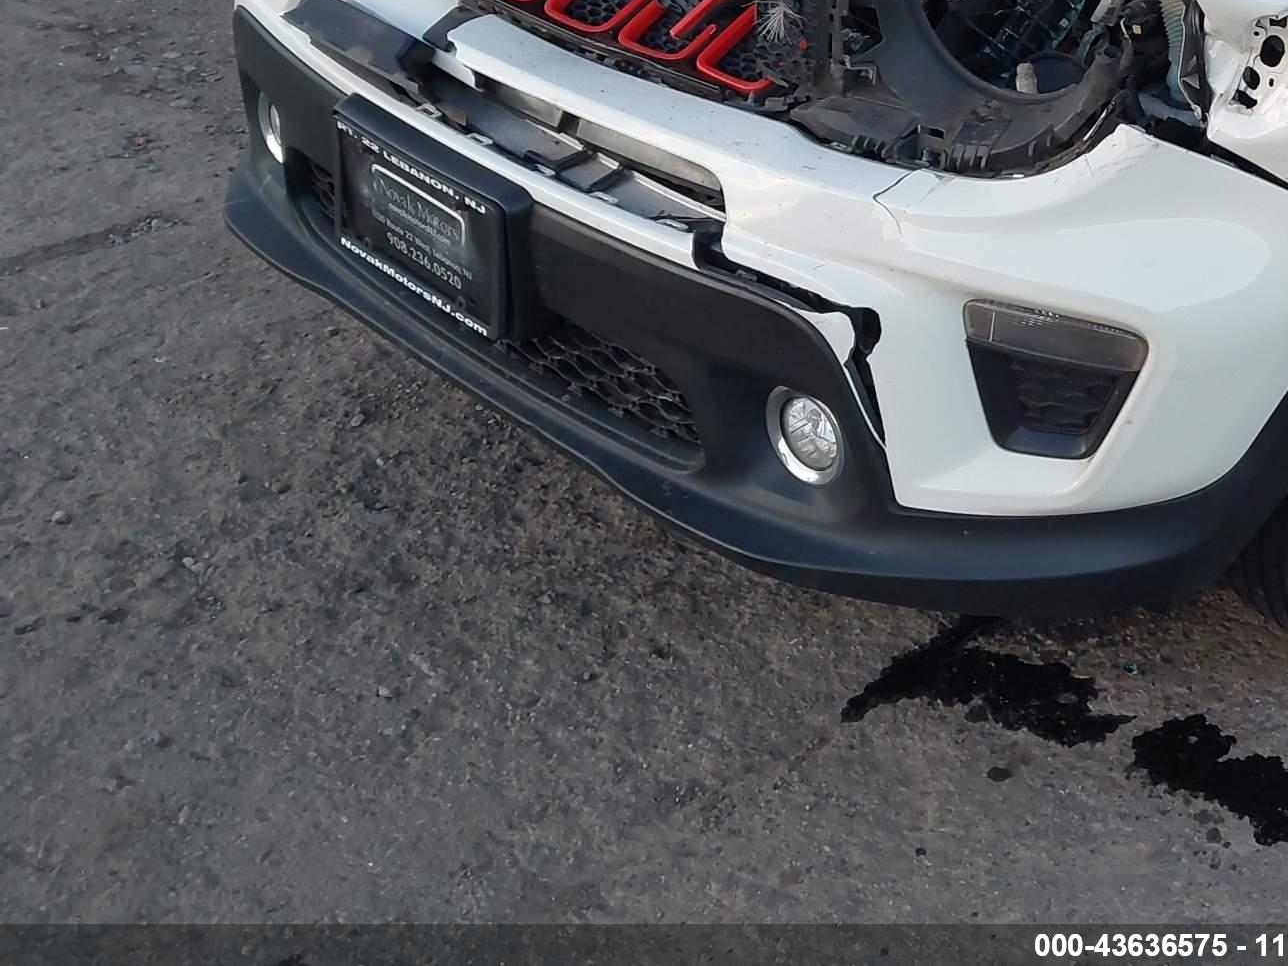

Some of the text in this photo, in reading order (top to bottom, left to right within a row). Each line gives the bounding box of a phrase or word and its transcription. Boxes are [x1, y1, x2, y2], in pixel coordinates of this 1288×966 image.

[336, 120, 486, 215] RT. 22 LEBANON, NJ
[417, 201, 459, 240] Motors
[341, 237, 488, 337] NovakMotorsNJ.com
[387, 232, 461, 290] 908.236.0520
